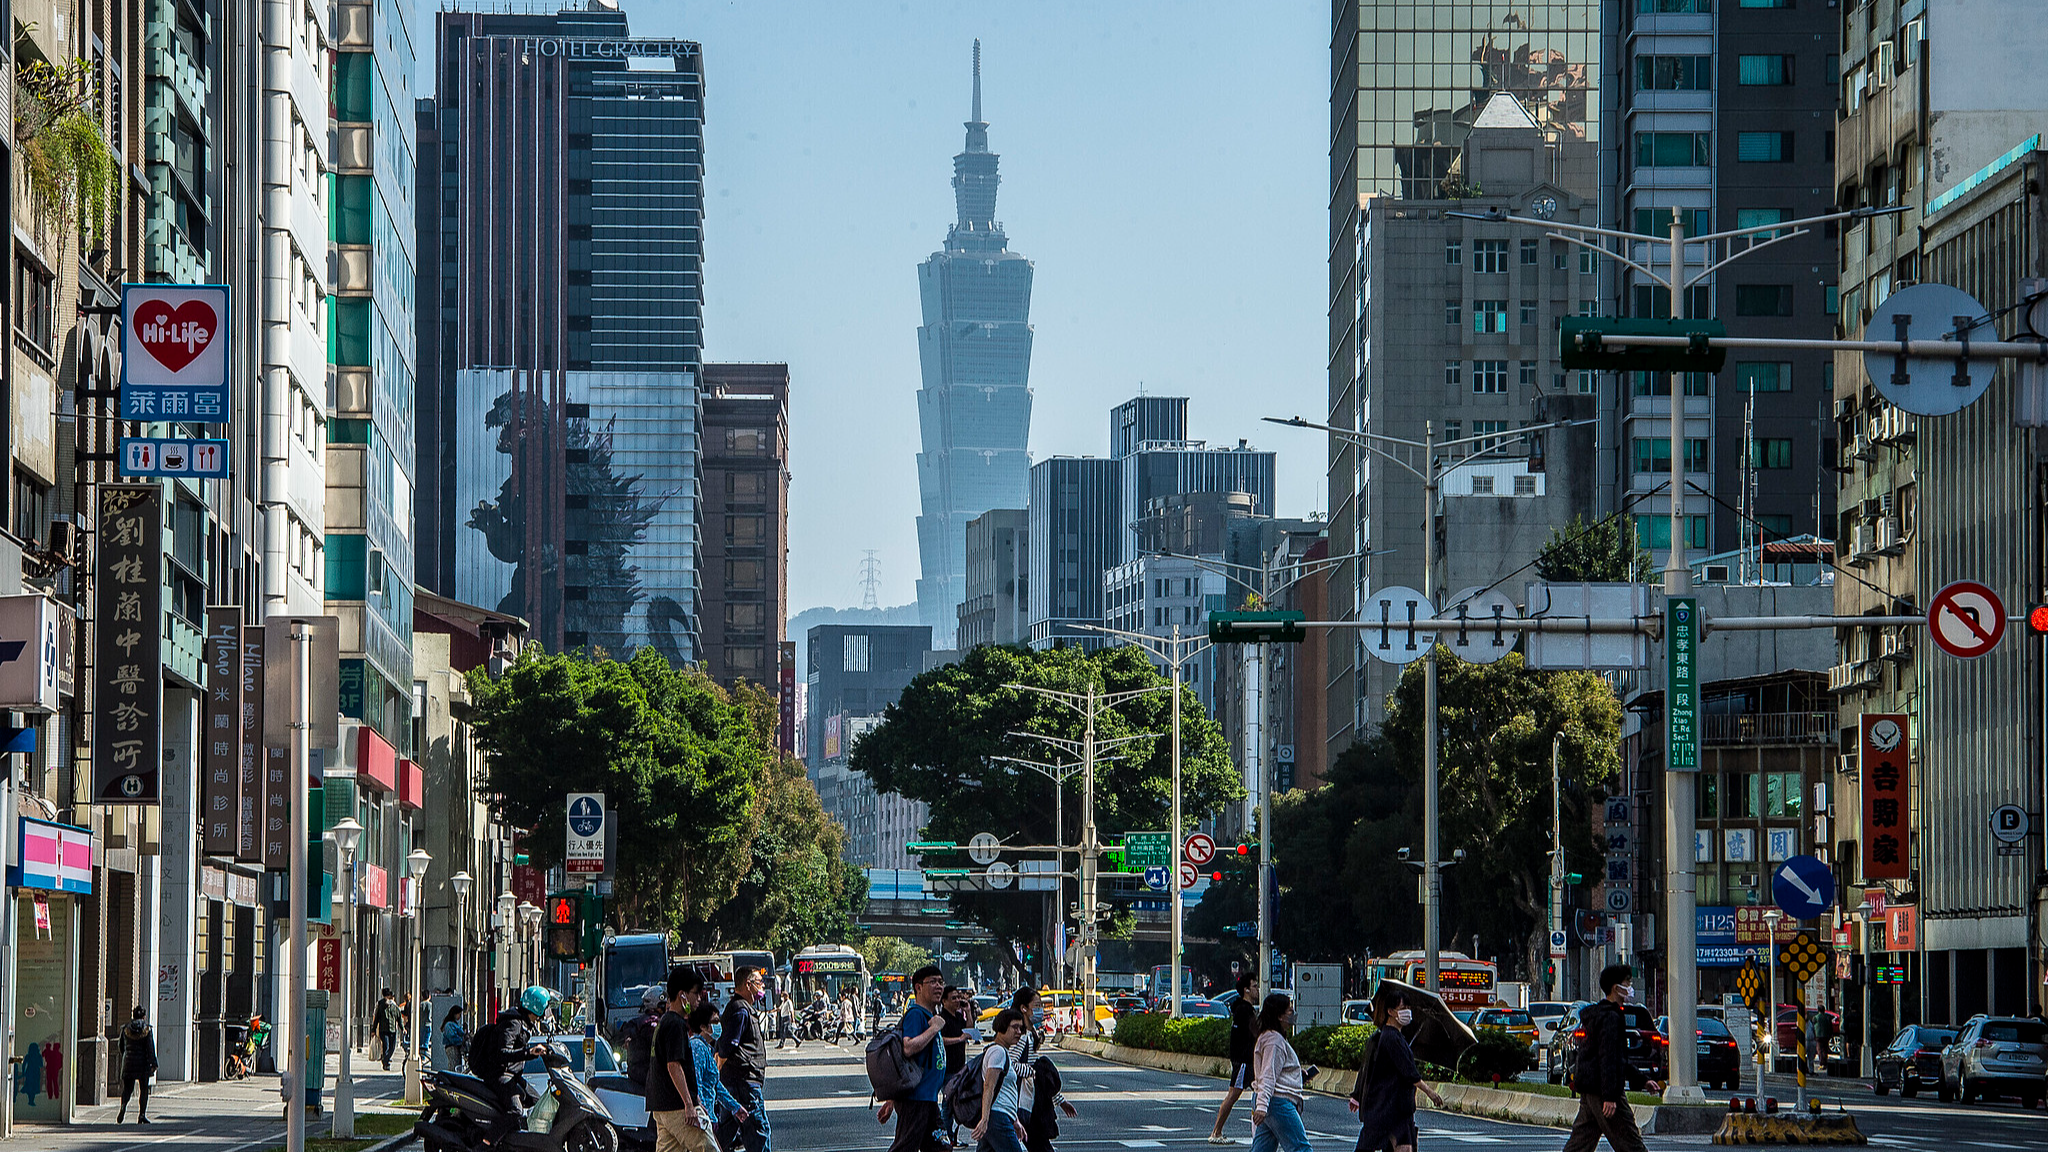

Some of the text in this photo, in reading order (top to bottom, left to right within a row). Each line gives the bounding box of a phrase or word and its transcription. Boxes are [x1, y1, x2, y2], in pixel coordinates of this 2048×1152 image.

[524, 39, 694, 58] HOTEL GRACERY
[129, 391, 221, 414] 萊爾富
[109, 516, 149, 770] 劉桂蘭中醫診所
[209, 625, 237, 675] Milano
[244, 643, 262, 692] Milano
[1676, 625, 1689, 706] 忠孝東路一段
[1672, 708, 1693, 717] Zhong
[212, 686, 230, 838] 米蘭時尚診所
[568, 840, 603, 850] 行人優先
[1705, 914, 1735, 930] H25
[322, 942, 334, 991] 台中銀行
